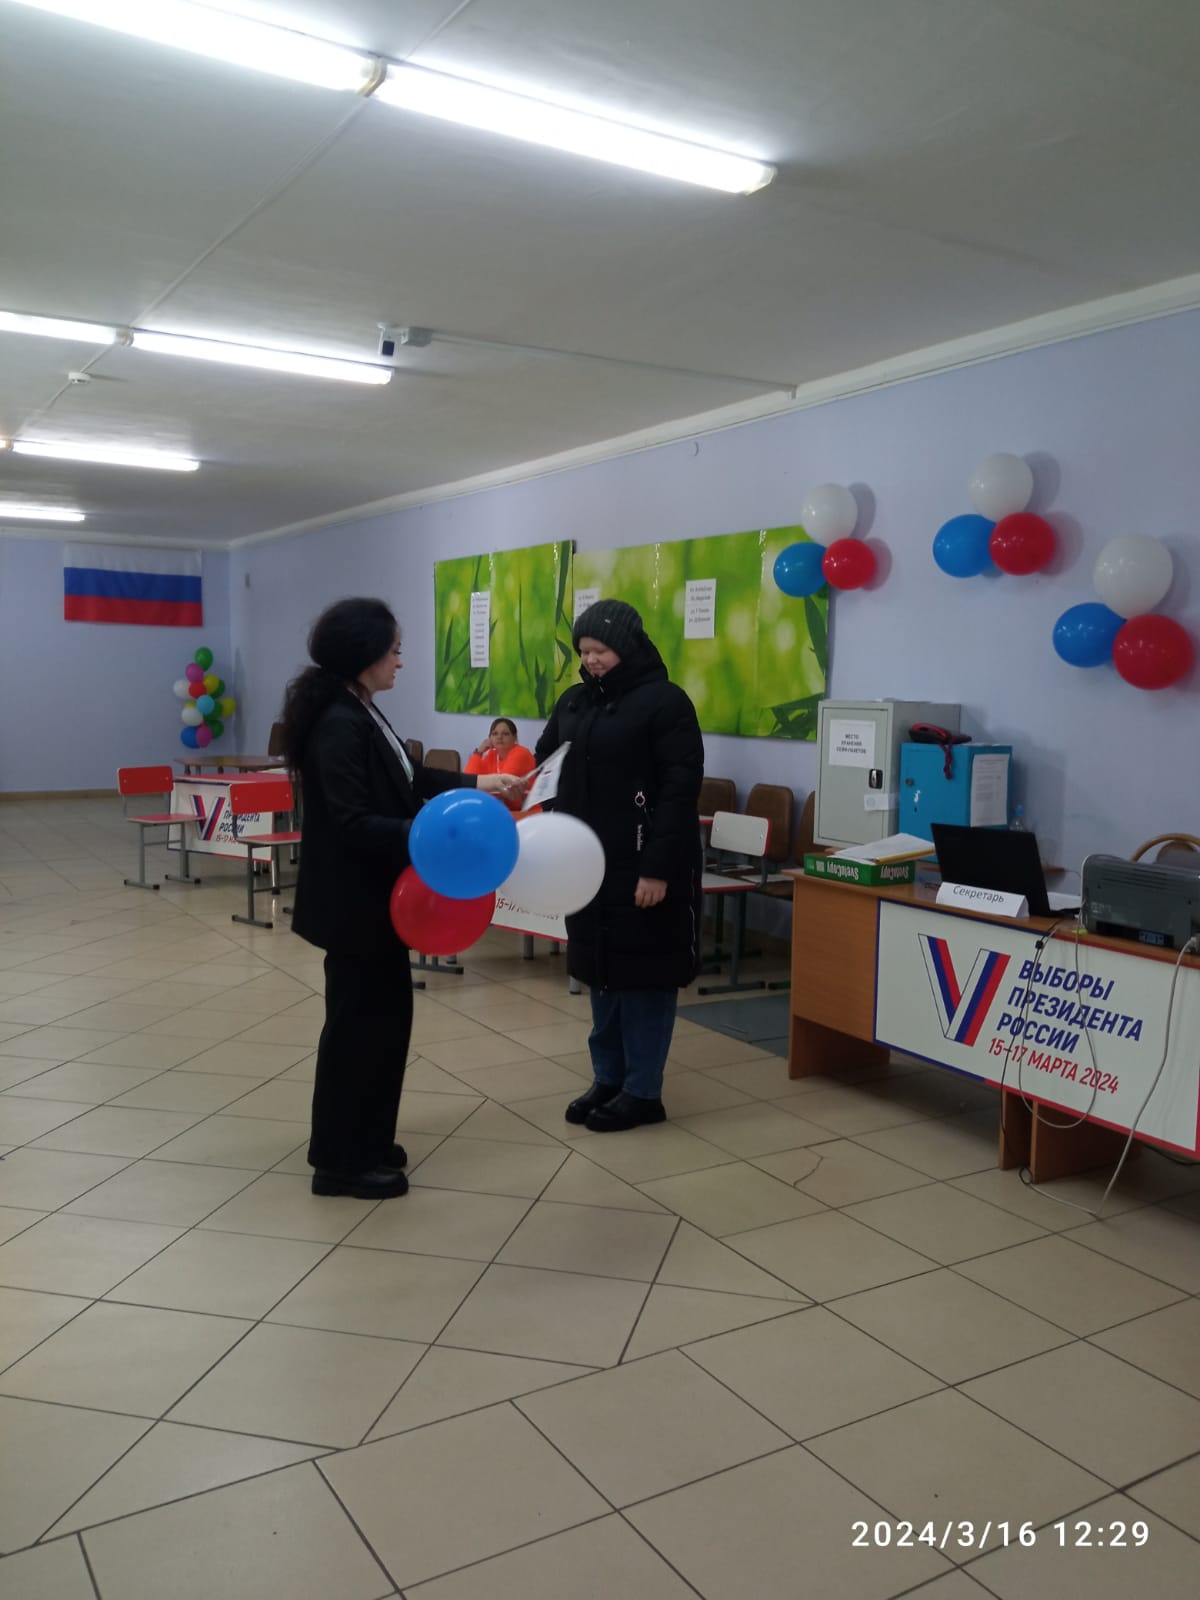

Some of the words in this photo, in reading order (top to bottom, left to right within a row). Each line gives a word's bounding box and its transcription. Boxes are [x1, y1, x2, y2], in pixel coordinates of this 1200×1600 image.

[953, 885, 1005, 903] Секретарь
[1018, 959, 1115, 1001] ВЫБОРЫ
[996, 1013, 1081, 1054] РОССИИ
[1007, 986, 1144, 1042] ПРЕЗИДЕНТА
[1027, 1050, 1078, 1081] МАРТА
[1079, 1067, 1120, 1094] 2024
